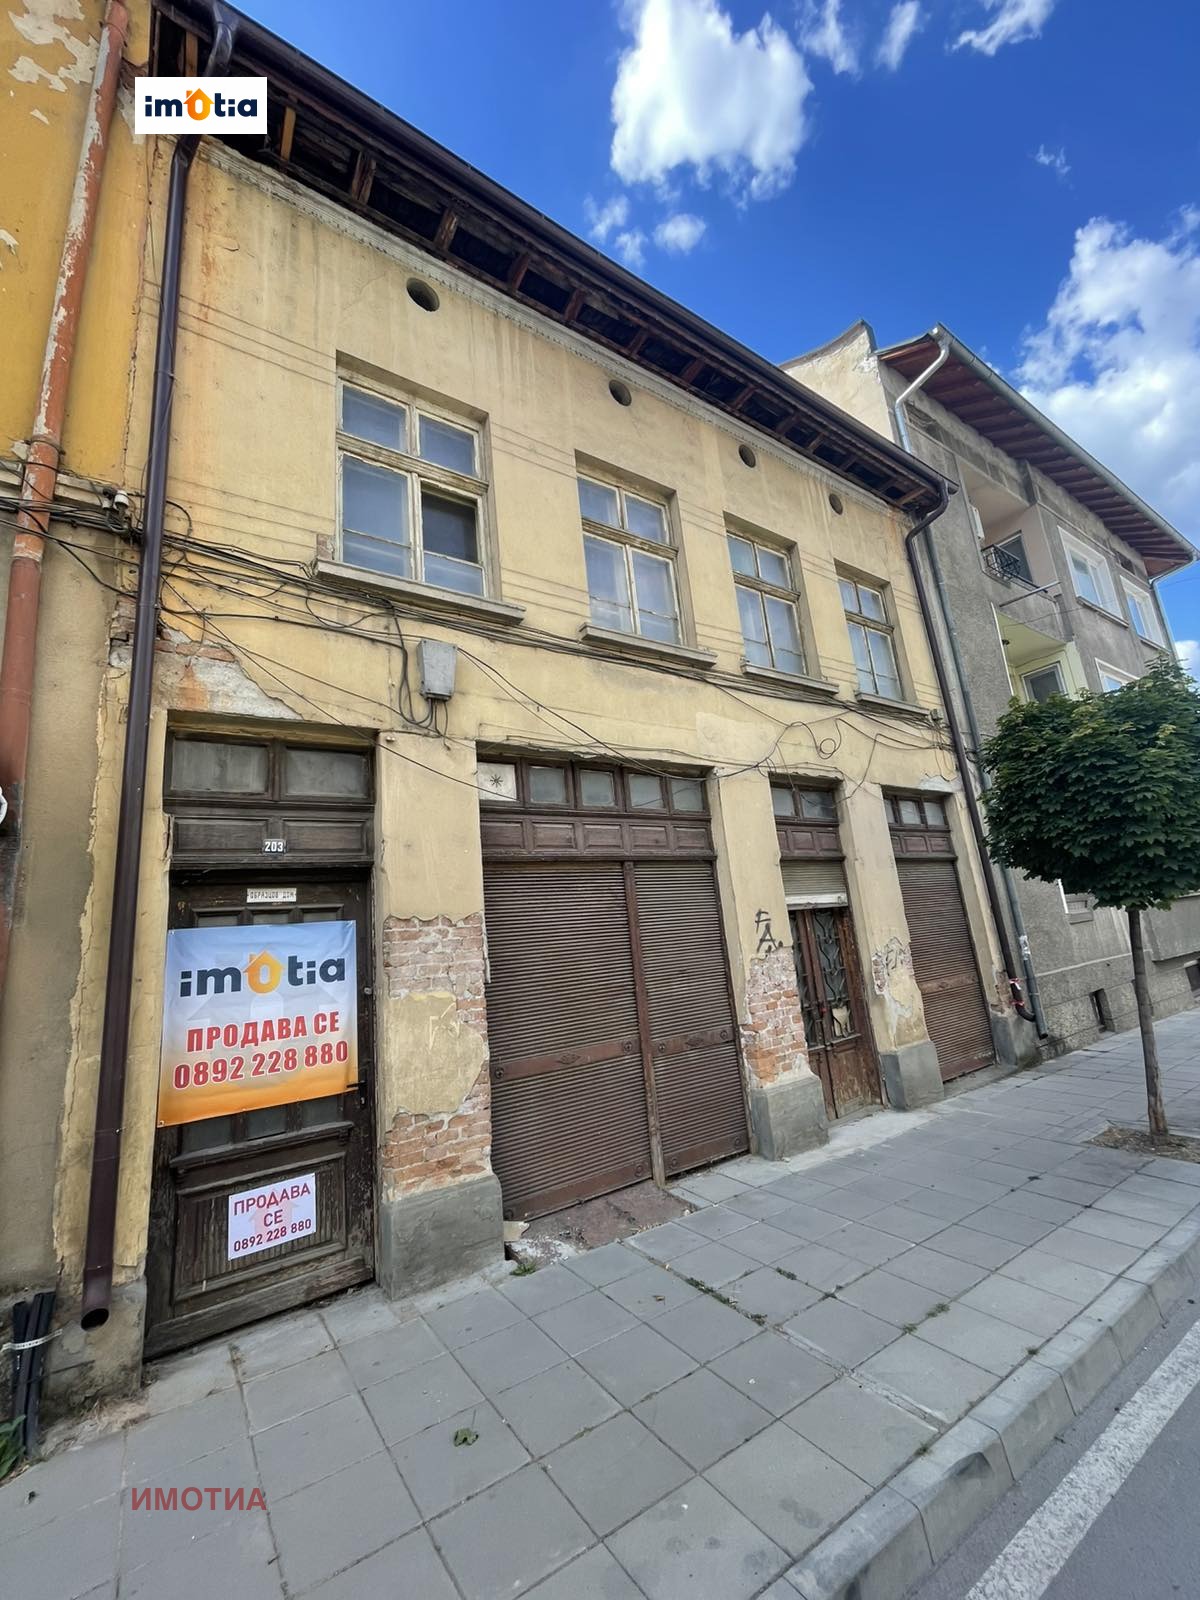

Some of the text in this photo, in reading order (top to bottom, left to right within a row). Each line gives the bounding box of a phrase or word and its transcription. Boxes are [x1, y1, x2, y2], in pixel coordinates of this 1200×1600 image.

[264, 841, 283, 852] 203
[187, 1011, 339, 1052] ПРОДАВА СЕ
[173, 1040, 348, 1089] 0892 228 880
[234, 1183, 311, 1216] ПРОДАВА
[263, 1209, 283, 1227] СЕ
[234, 1219, 311, 1252] 0892 228 880
